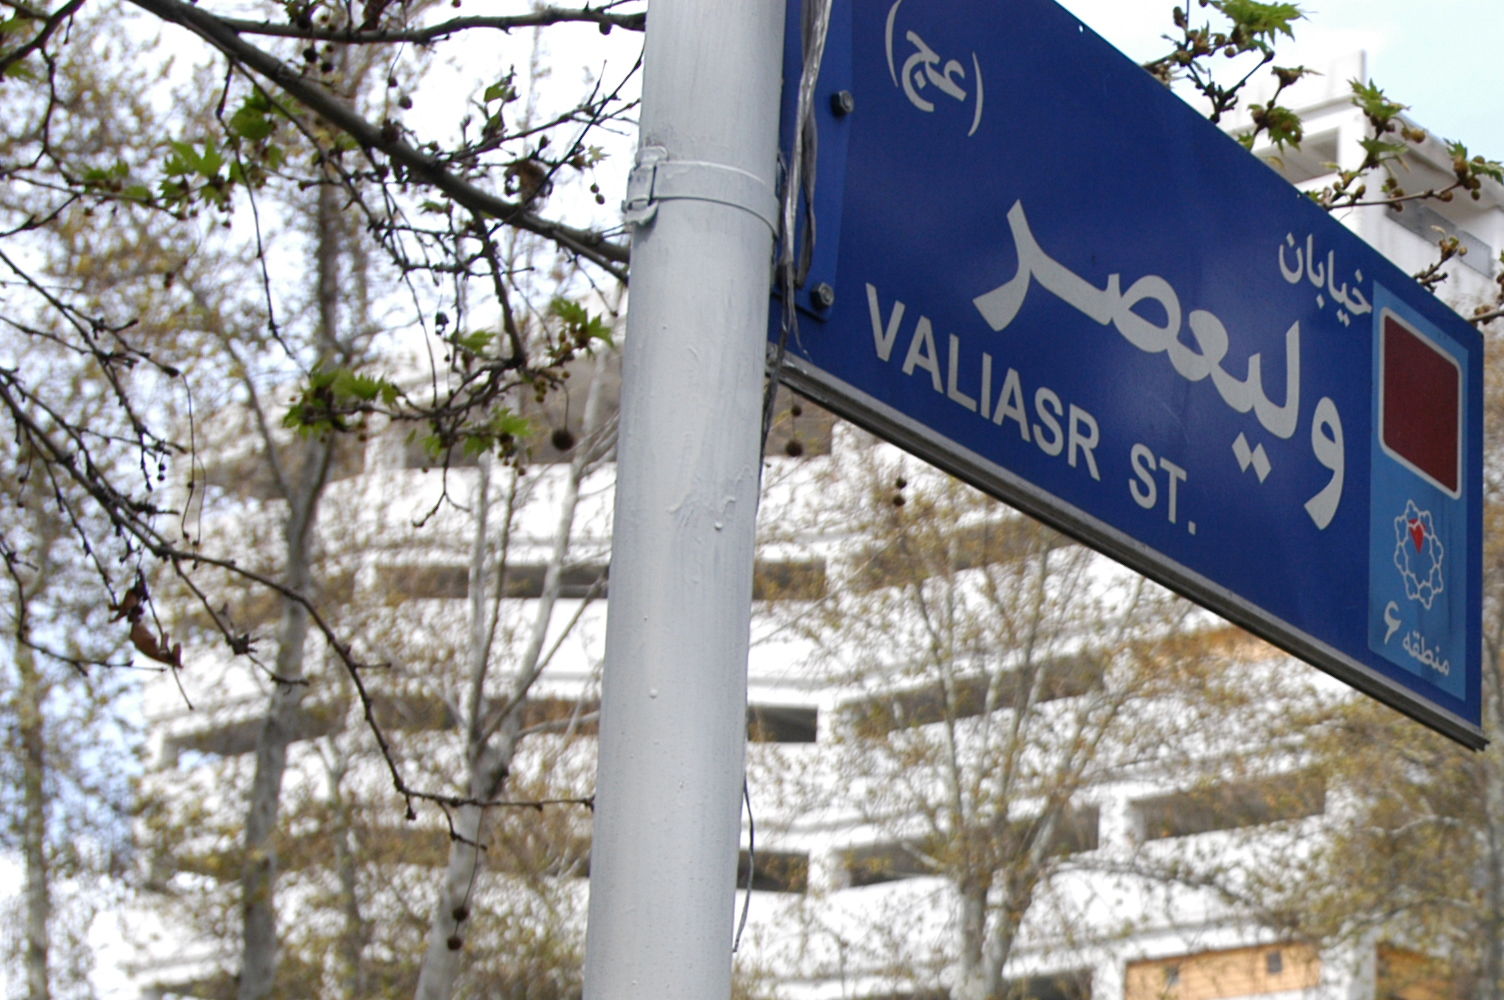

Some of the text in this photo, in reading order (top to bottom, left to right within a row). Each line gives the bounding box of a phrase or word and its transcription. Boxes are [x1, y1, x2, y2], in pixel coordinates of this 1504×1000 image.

[973, 199, 1345, 530] ولیعصر
[1278, 232, 1372, 327] خیابان
[866, 283, 1196, 534] VALIASR ST.
[1383, 600, 1449, 676] منطقه ۶
